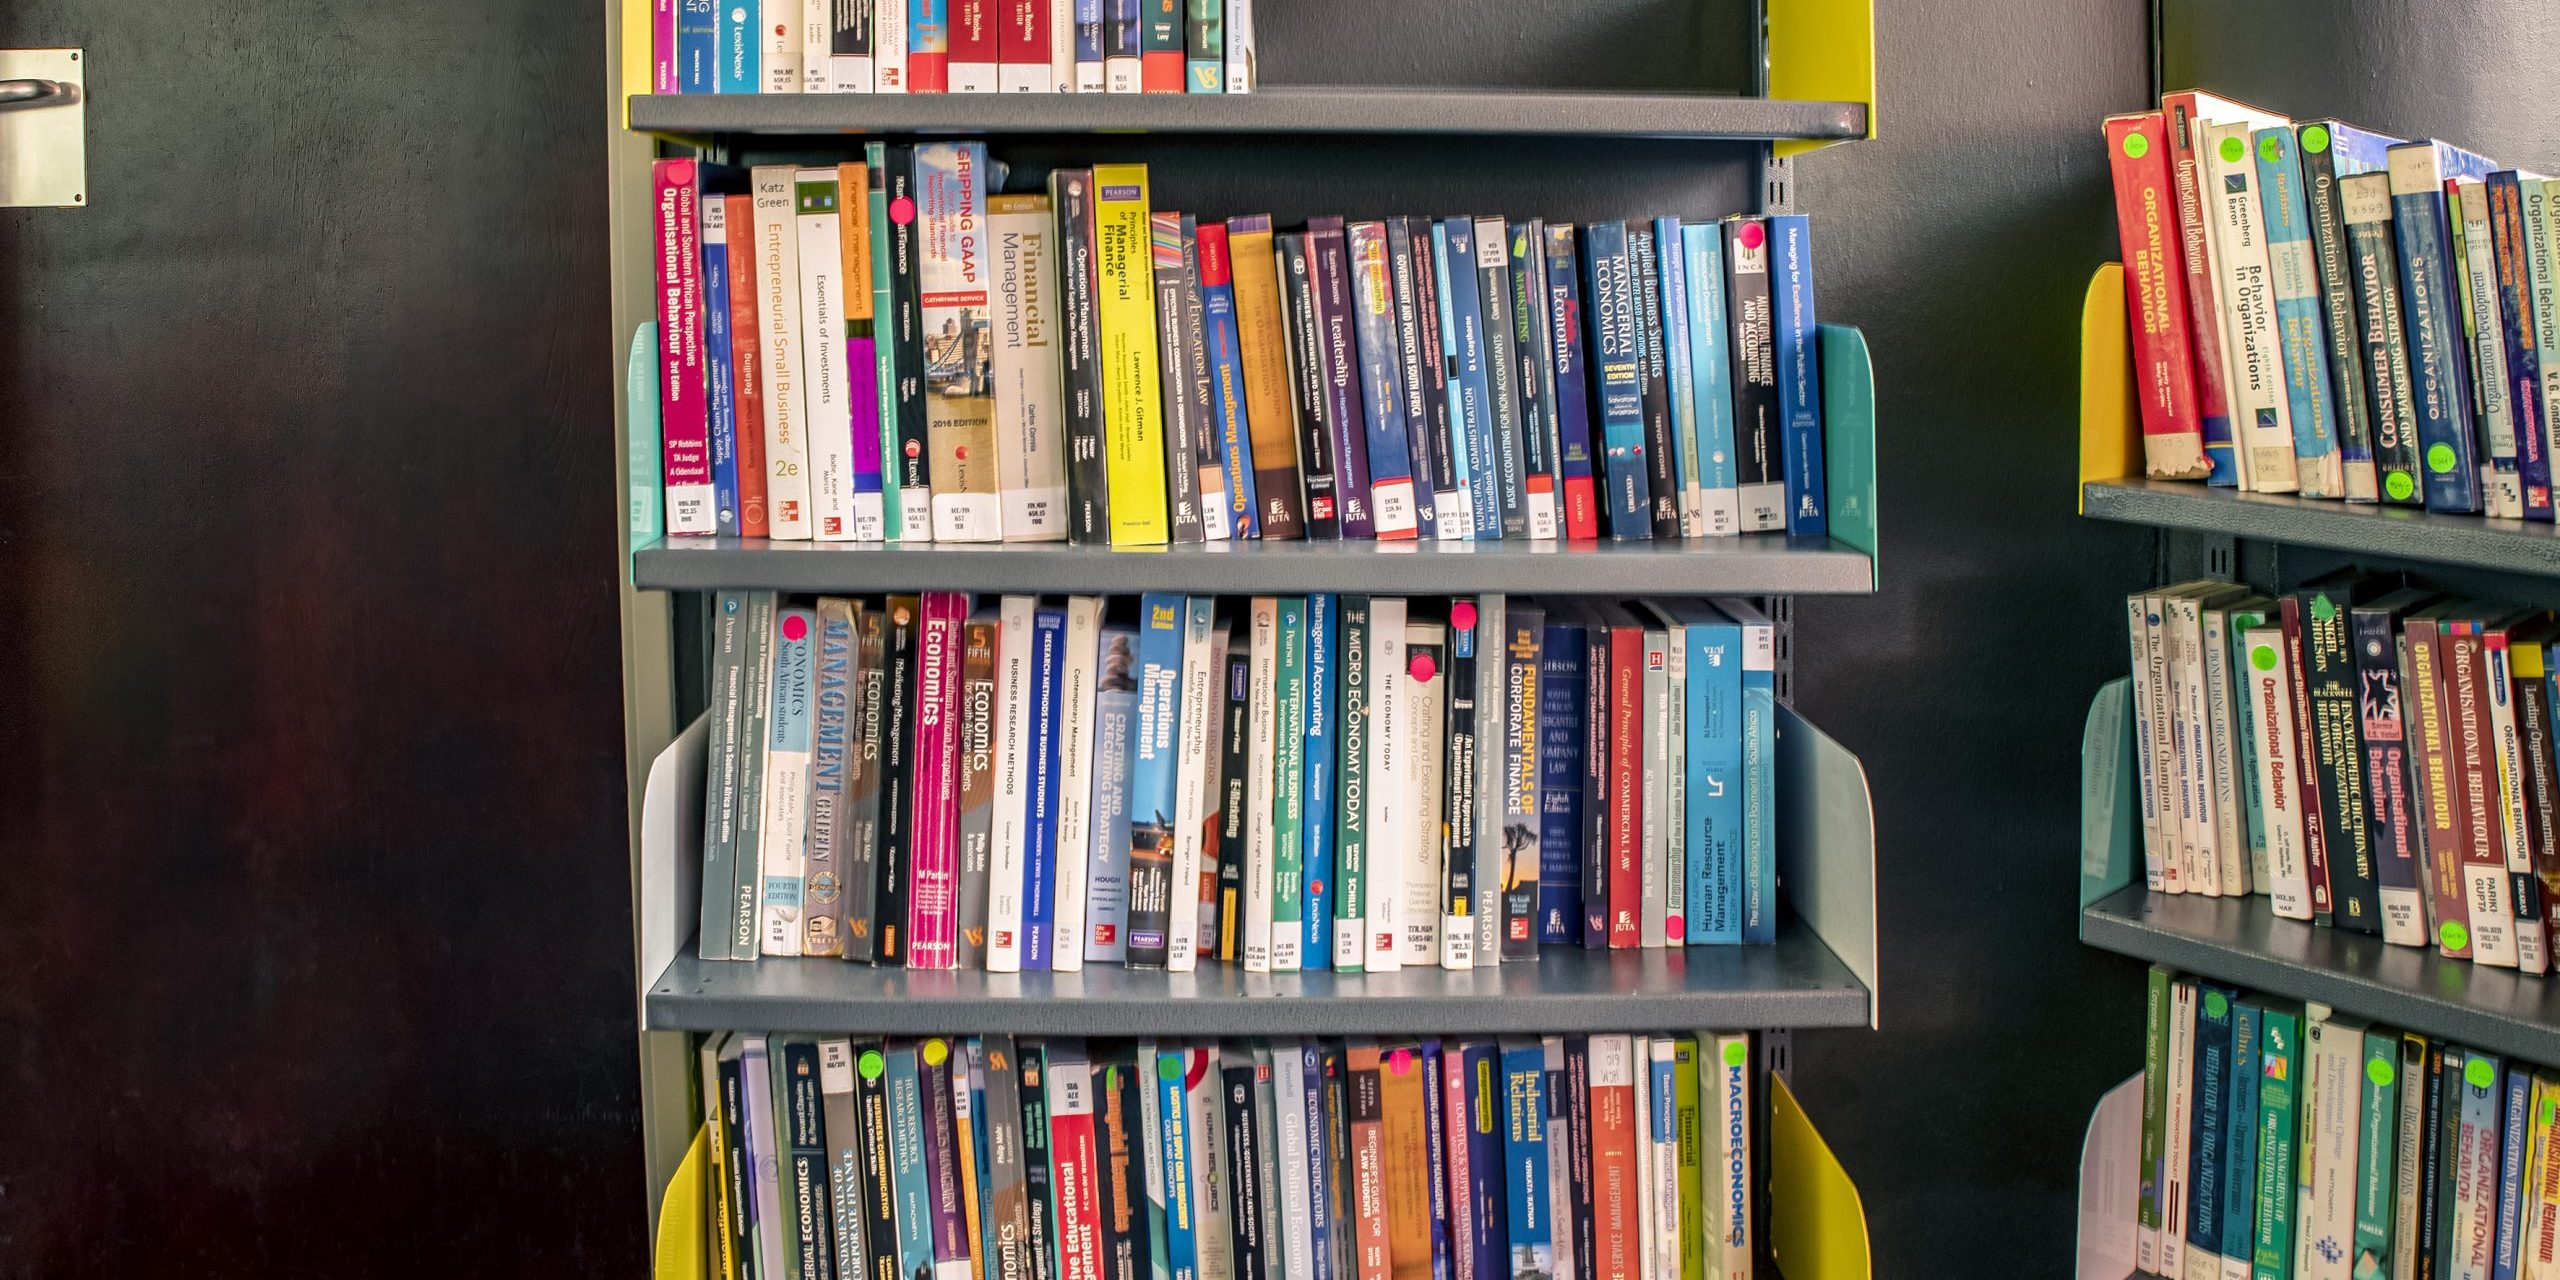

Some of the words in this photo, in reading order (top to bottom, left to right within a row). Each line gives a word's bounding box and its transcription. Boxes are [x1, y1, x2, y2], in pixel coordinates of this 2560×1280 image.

[734, 26, 744, 79] LexisNexis
[680, 187, 691, 215] Global
[957, 149, 972, 230] GRIPPING
[2174, 159, 2201, 226] Organisational
[2228, 198, 2238, 226] Baron
[661, 187, 680, 283] Organisational
[681, 217, 691, 234] and
[1119, 211, 1126, 220] of
[1126, 211, 1137, 254] Principles
[2237, 196, 2251, 247] Greenberg
[682, 236, 692, 274] Southern
[961, 236, 975, 282] GAAP
[1076, 248, 1087, 299] Operations
[1104, 224, 1114, 276] Finance
[1114, 224, 1129, 299] Managerial
[1637, 233, 1657, 275] Applied
[1786, 228, 1799, 269] Managing
[2143, 187, 2169, 333] ORGANIZATIONAL
[2185, 227, 2207, 275] Behaviour
[2235, 266, 2248, 281] in
[2313, 175, 2342, 287] Organizational
[2329, 291, 2351, 358] Behavior
[683, 277, 694, 308] African
[766, 223, 787, 334] Entrepreneurial
[816, 275, 827, 324] Essentials
[999, 232, 1022, 348] Management
[1021, 232, 1048, 348] Financial
[1396, 253, 1411, 303] GOVERNMENT
[1791, 271, 1800, 282] for
[2135, 249, 2156, 334] BEHAVIOR
[2248, 265, 2269, 332] Behavior
[2359, 253, 2385, 344] BEHAVIOR
[667, 288, 683, 354] Behaviour
[1401, 305, 1413, 320] AND
[1596, 258, 1616, 355] ECONOMICS
[1612, 255, 1632, 356] MANAGERIAL
[1643, 279, 1659, 326] Business
[1743, 300, 1755, 320] AND
[1755, 295, 1770, 345] MUNICIPAL
[1791, 284, 1802, 325] Excellence
[683, 311, 696, 366] Perspectives
[819, 327, 828, 338] of
[1078, 302, 1090, 359] Management
[1331, 315, 1348, 387] Leadership
[1402, 321, 1416, 354] POLITICS
[1553, 285, 1572, 373] Economics
[1648, 330, 1664, 377] Statistics
[1744, 322, 1760, 382] ACCOUNTING
[1794, 328, 1802, 337] in
[1795, 338, 1804, 352] the
[2235, 286, 2263, 391] Organizations
[2412, 256, 2439, 420] ORGANIZATIONS
[670, 360, 679, 373] 3rd
[774, 338, 789, 377] Small
[819, 342, 831, 403] Investments
[1133, 351, 1143, 395] Lawrence
[1405, 355, 1417, 364] IN
[1406, 365, 1419, 388] SOUTH
[1759, 346, 1773, 386] FINANCE
[1796, 353, 1805, 379] Public
[670, 375, 680, 400] Edition
[1409, 390, 1422, 416] AFRICA
[1797, 381, 1807, 406] Sector
[2370, 347, 2397, 448] CONSUMER
[777, 382, 792, 444] Business
[1135, 407, 1145, 441] Gitman
[1463, 387, 1479, 470] ADMINISTRATION
[776, 460, 798, 477] 2e
[1472, 478, 1484, 531] MUNICIPAL
[1311, 595, 1325, 662] Managerial
[2150, 634, 2160, 651] The
[923, 619, 946, 727] Economics
[1010, 658, 1018, 701] BUSINESS
[1348, 628, 1361, 684] MICRO
[729, 666, 738, 698] Financial
[815, 618, 849, 794] MANAGEMENT
[964, 681, 973, 694] for
[1309, 664, 1324, 736] Accounting
[1509, 665, 1521, 746] CORPORATE
[1622, 668, 1631, 706] General
[2149, 656, 2169, 745] Organizational
[725, 699, 736, 743] Management
[864, 669, 883, 760] Economics
[963, 695, 973, 721] South
[973, 680, 992, 771] Economics
[1008, 704, 1016, 750] RESEARCH
[1137, 663, 1159, 759] Management
[1153, 669, 1176, 749] Operations
[1191, 671, 1206, 755] Entrepreneurship
[1289, 678, 1298, 767] INTERNATIONAL
[1347, 690, 1360, 773] ECONOMY
[1521, 665, 1535, 790] FUNDAMENTALS
[1620, 709, 1631, 754] Principles
[2262, 677, 2282, 758] Organizational
[963, 723, 973, 753] African
[1101, 712, 1114, 790] EXECUTING
[1113, 713, 1125, 782] CRAFTING
[2414, 642, 2440, 752] ORGANIZATIONAL
[2428, 756, 2450, 830] BEHAVIOUR
[2454, 642, 2480, 768] ORGANISATIONAL
[2467, 770, 2489, 858] BEHAVIOUR
[724, 753, 733, 784] Southern
[962, 755, 972, 791] students
[1006, 753, 1014, 795] METHODS
[1508, 754, 1520, 814] FINANCE
[1619, 757, 1631, 768] of
[2155, 749, 2173, 811] Champion
[2270, 761, 2287, 811] Behavior
[2369, 747, 2387, 823] Behaviour
[722, 809, 731, 819] 5th
[723, 786, 732, 807] Africa
[1111, 785, 1122, 814] AND
[1288, 770, 1297, 819] BUSINESS
[1347, 778, 1359, 831] TODAY
[1521, 796, 1534, 815] OF
[1621, 771, 1629, 845] COMMERCIAL
[2384, 746, 2411, 859] Organisational
[721, 821, 730, 842] edition
[811, 797, 831, 862] GRIFFIN
[1098, 794, 1111, 862] STRATEGY
[1702, 817, 1712, 879] Resource
[1621, 849, 1629, 871] LAW
[1347, 878, 1356, 918] SCHILLER
[1702, 884, 1711, 932] Human
[1714, 841, 1727, 931] Management
[2474, 878, 2486, 912] GUPTA
[738, 885, 751, 945] PEARSON
[1311, 898, 1320, 943] LexisNexis
[1481, 890, 1492, 950] PEARSON
[1510, 1072, 1525, 1141] Relations
[1525, 1070, 1541, 1141] Industrial
[1284, 1113, 1299, 1157] Global
[1360, 1149, 1368, 1169] LAW
[1367, 1129, 1378, 1183] BEGINNER'S
[1729, 1065, 1744, 1247] MACROECONOMICS
[1060, 1162, 1078, 1253] Educational
[1287, 1160, 1302, 1210] Political
[1361, 1171, 1370, 1218] STUDENTS
[1370, 1186, 1379, 1214] GUIDE
[1288, 1216, 1305, 1276] Economy
[1371, 1217, 1380, 1236] FOR
